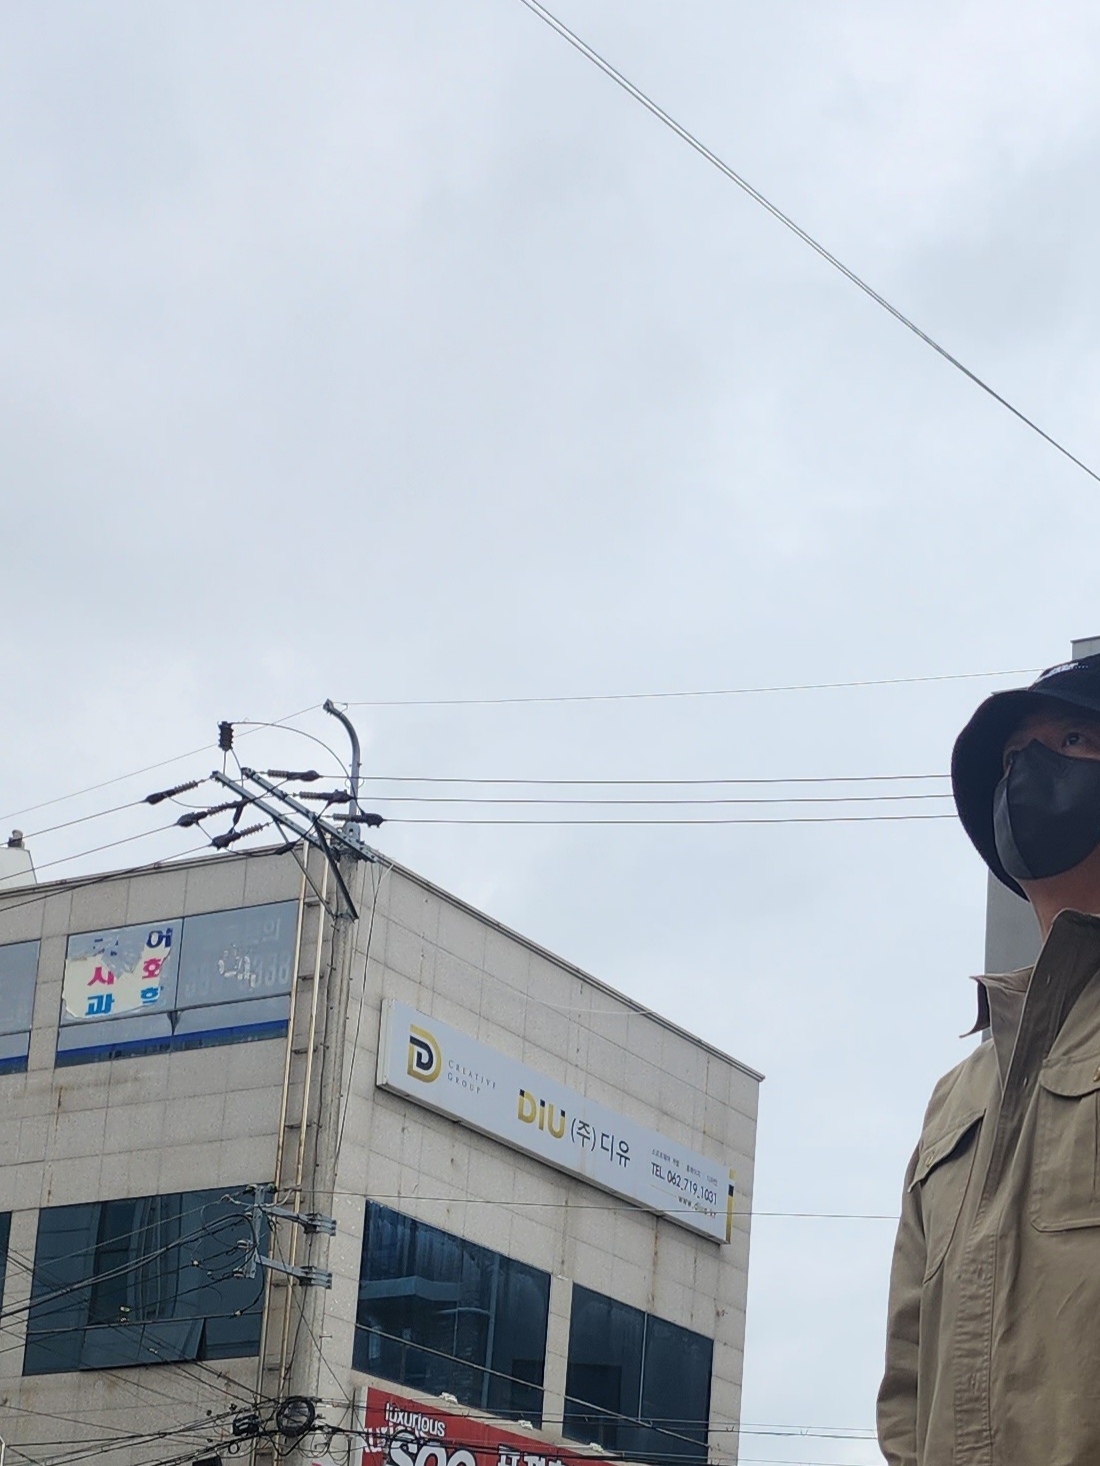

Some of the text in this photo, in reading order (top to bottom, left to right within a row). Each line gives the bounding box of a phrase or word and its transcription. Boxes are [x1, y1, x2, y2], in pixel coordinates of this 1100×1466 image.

[447, 1072, 481, 1094] GROUP
[570, 1118, 631, 1168] (주)디유
[385, 1402, 446, 1437] luxurious
